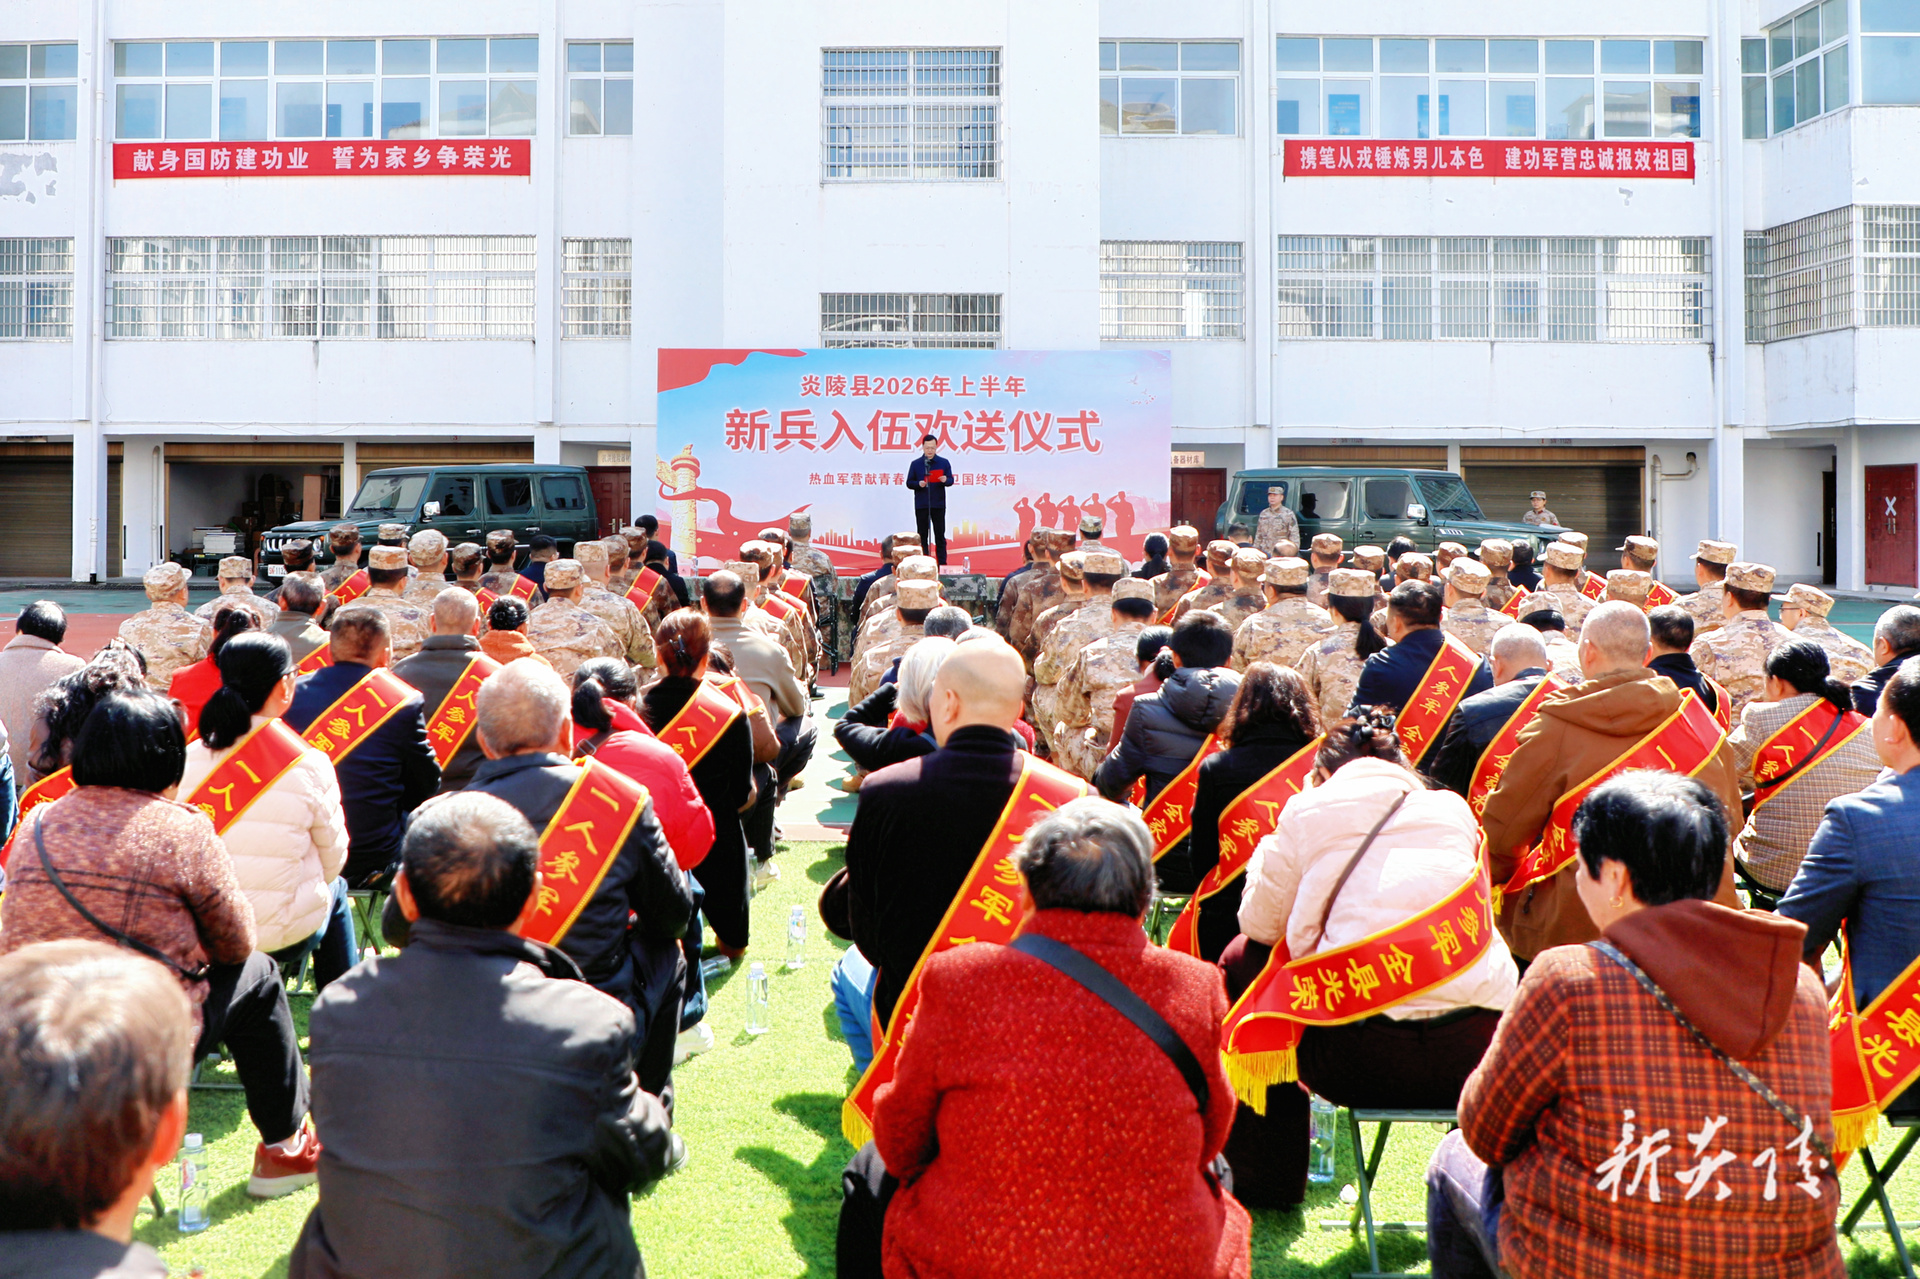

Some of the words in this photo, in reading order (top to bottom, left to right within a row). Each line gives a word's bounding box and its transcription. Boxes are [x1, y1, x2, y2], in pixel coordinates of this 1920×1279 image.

[133, 147, 310, 172] 献身国防建功业
[332, 145, 513, 170] 誓为家乡争荣光
[1299, 146, 1485, 170] 携笔从戎锤炼男儿本色
[1505, 146, 1689, 172] 建功军营忠诚报效祖国
[800, 375, 1026, 397] 炎陵县2026年上半年
[725, 408, 1102, 453] 新兵入伍欢送仪式
[809, 472, 905, 486] 热血军营献青春
[1171, 455, 1200, 464] 备器材库
[307, 687, 388, 752] 一人参军
[431, 674, 484, 744] 一人参军
[538, 786, 630, 917] 一人参军
[970, 792, 1058, 927] 一参军
[1288, 943, 1414, 1012] 全县光荣
